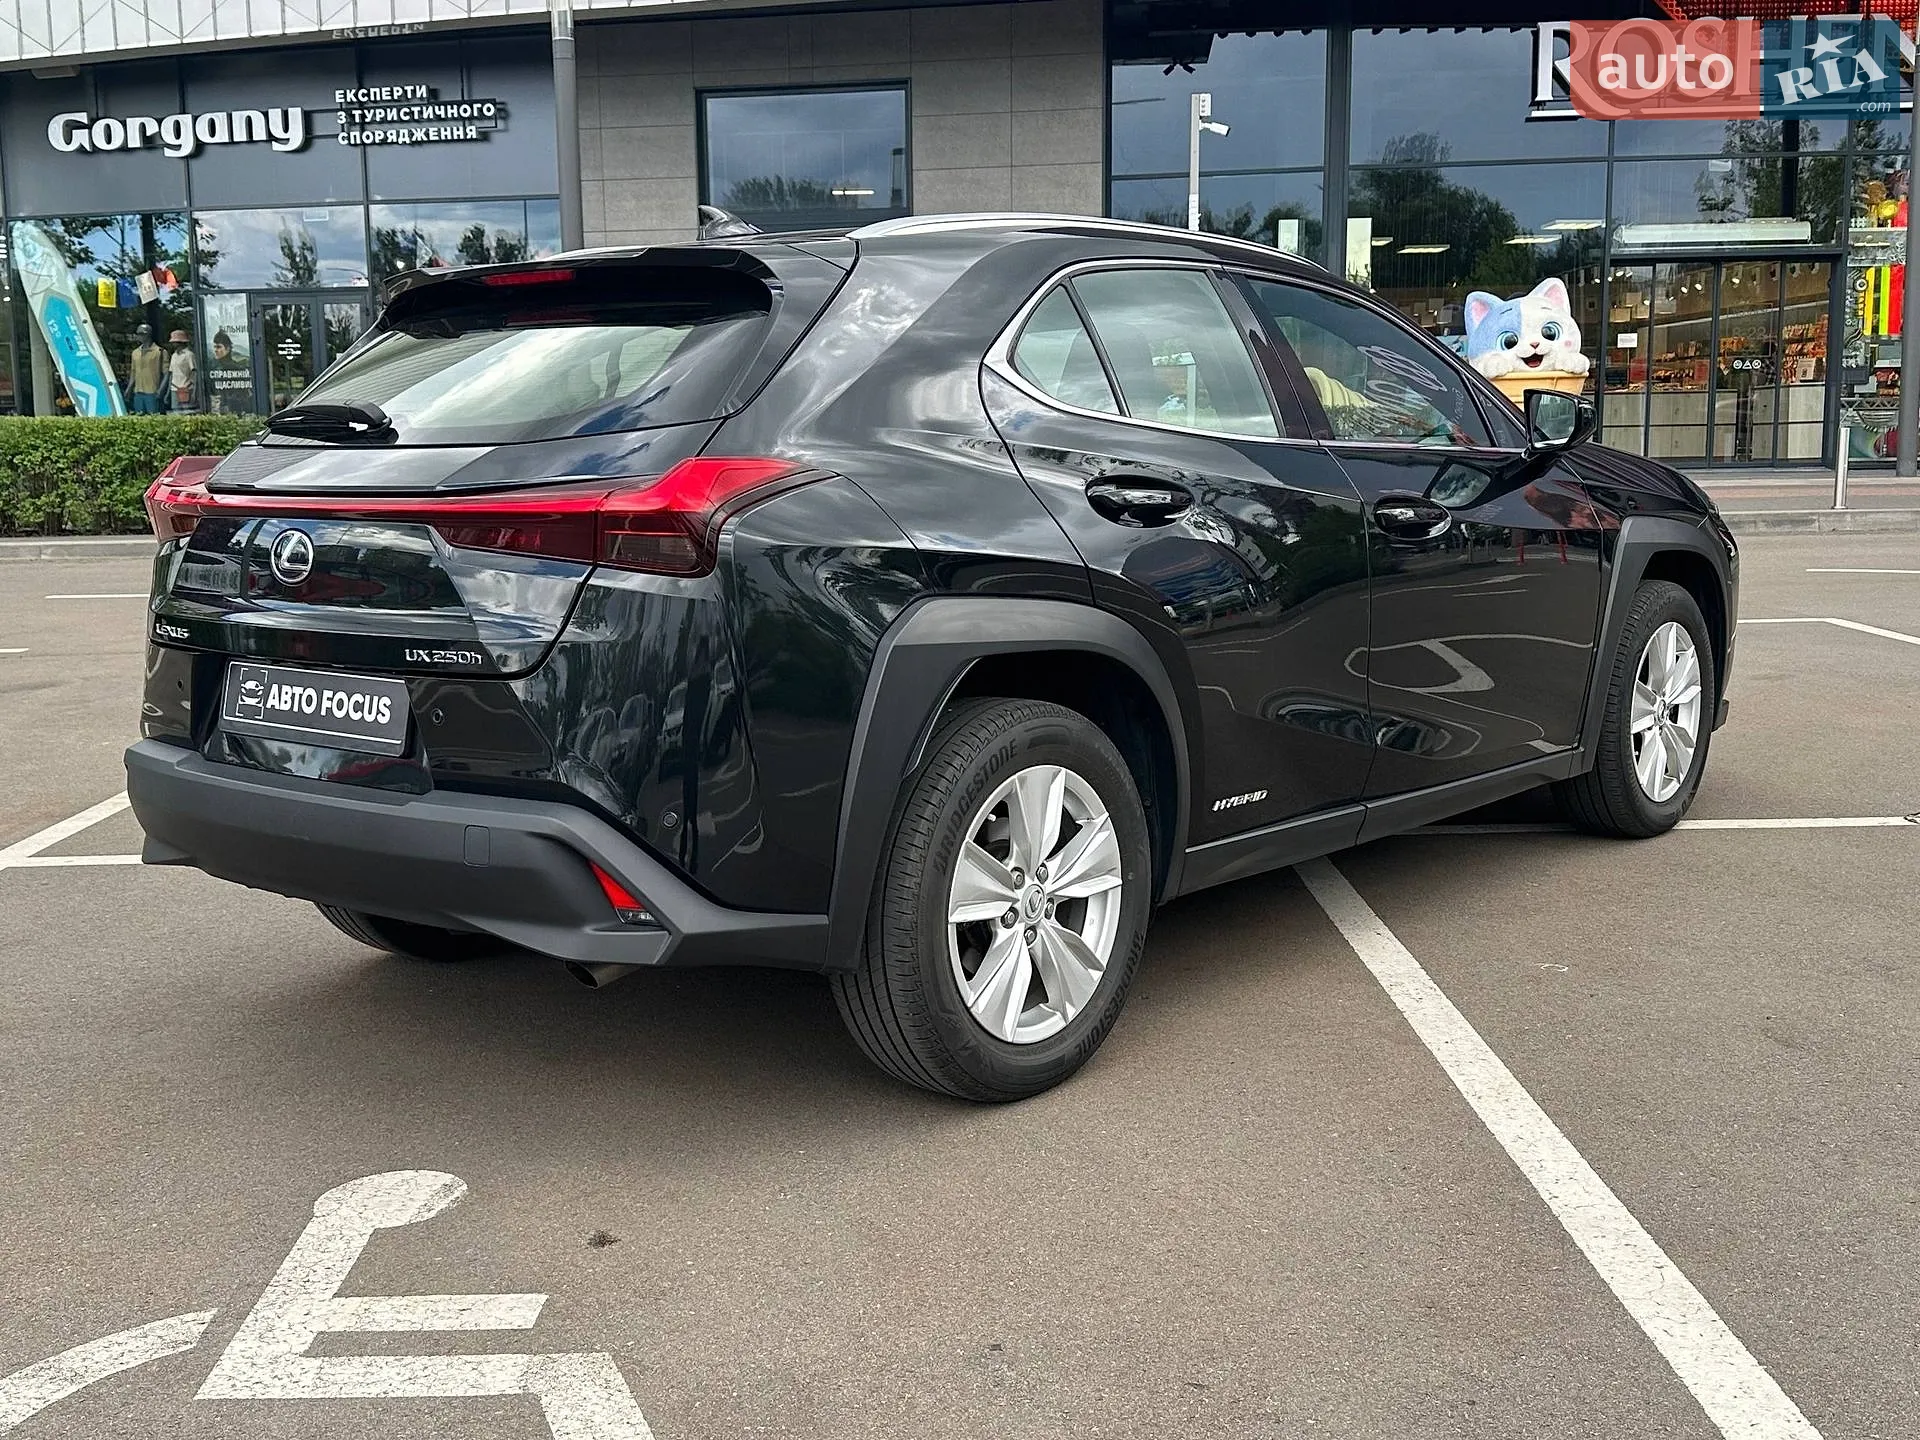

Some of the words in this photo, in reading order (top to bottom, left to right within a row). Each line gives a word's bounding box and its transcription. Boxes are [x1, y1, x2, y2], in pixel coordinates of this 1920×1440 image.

[335, 84, 428, 104] ЕКСПЕРТИ
[352, 102, 496, 124] ТУРИСТИЧНОГО
[47, 106, 305, 158] Gorgany
[337, 125, 478, 146] СПОРЯДЖЕННЯ
[155, 623, 190, 639] LEXUS
[265, 683, 318, 715] АВТО
[320, 689, 392, 725] FOCUS
[1211, 789, 1268, 812] HYBRID
